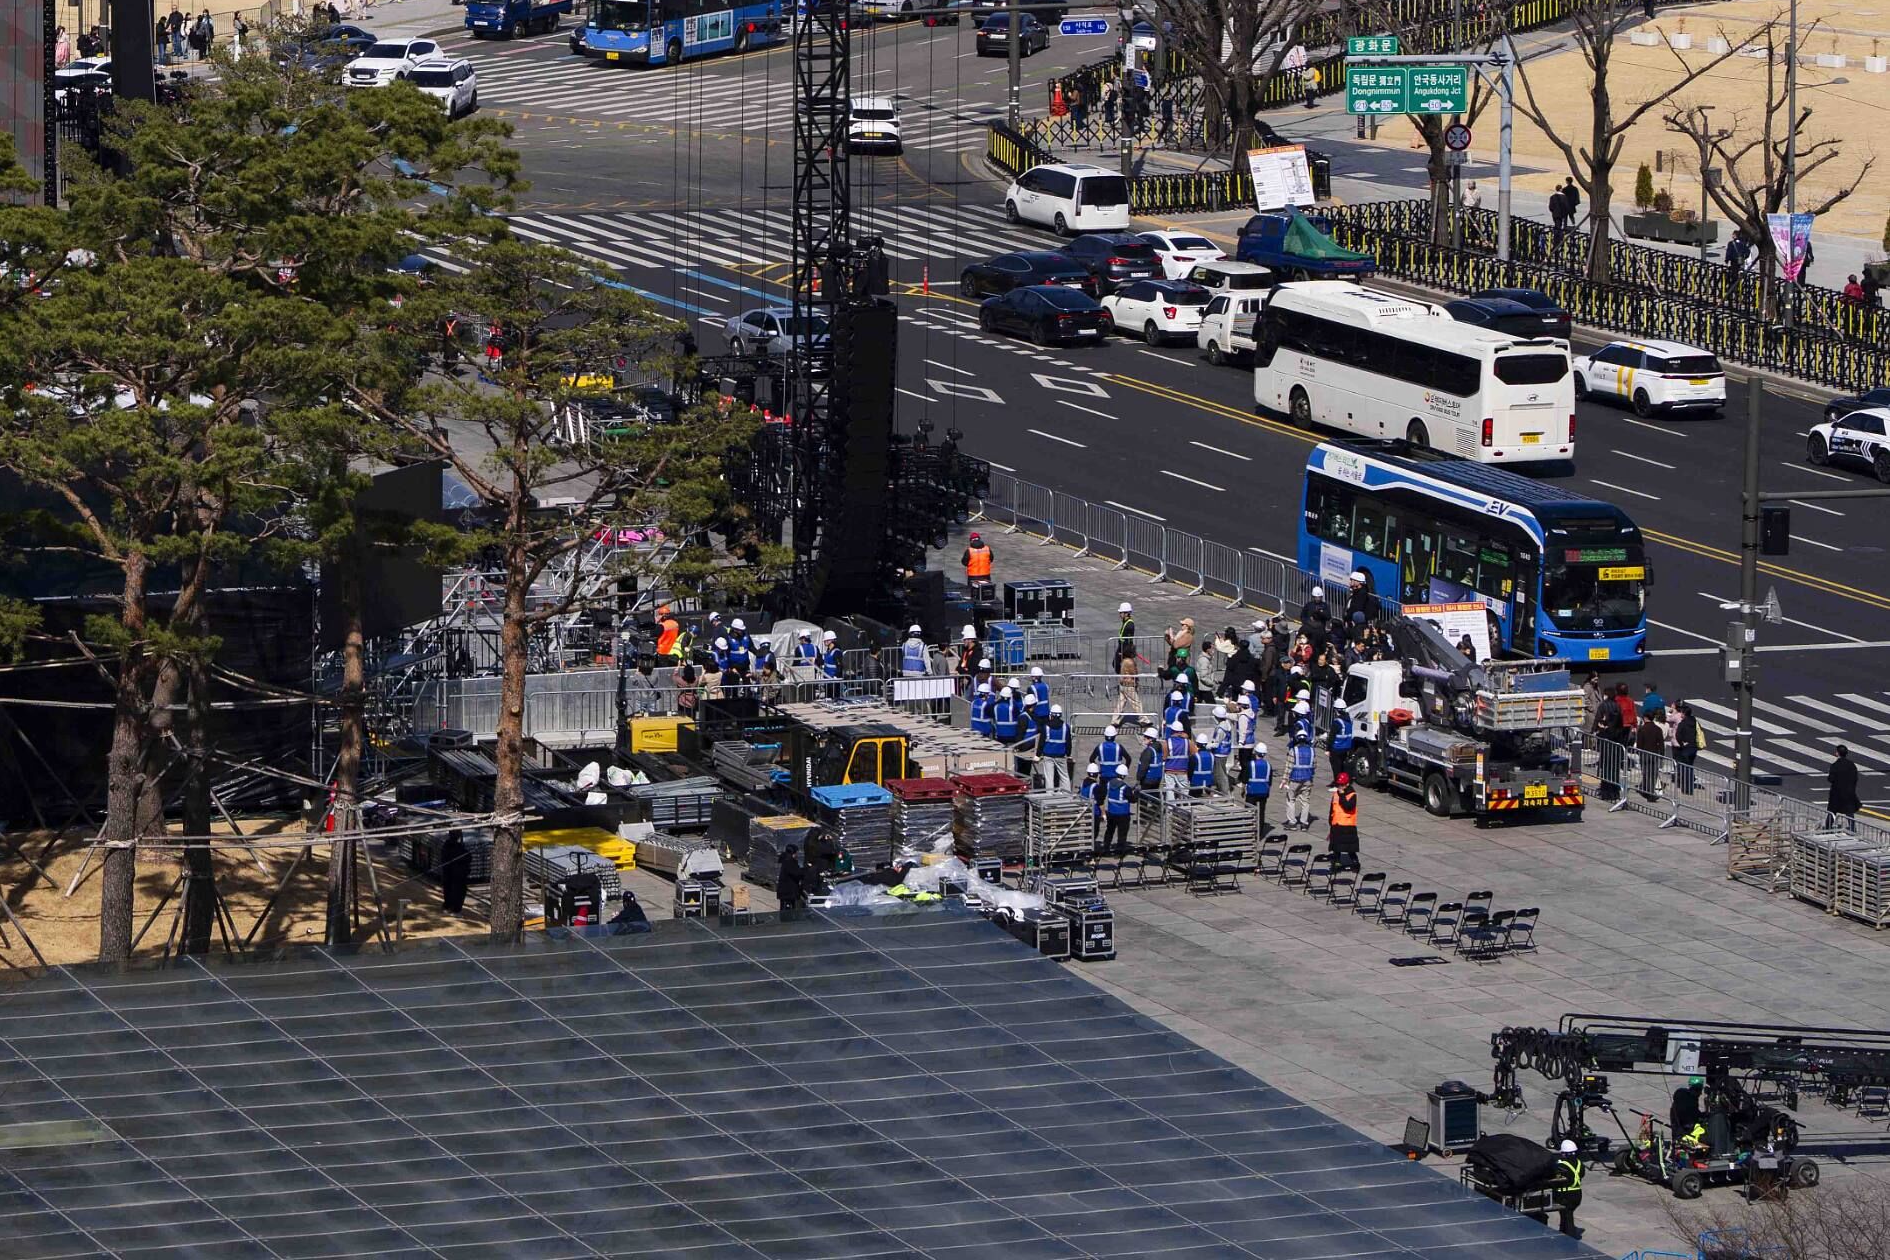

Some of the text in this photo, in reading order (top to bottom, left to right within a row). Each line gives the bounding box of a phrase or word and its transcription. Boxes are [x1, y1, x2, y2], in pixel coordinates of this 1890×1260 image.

[1354, 39, 1392, 52] 광화문
[1352, 74, 1377, 86] 독립문
[1413, 73, 1462, 86] 안국동사거리
[1352, 87, 1401, 97] Dongnimmun
[1413, 87, 1462, 97] Angukdong Jct
